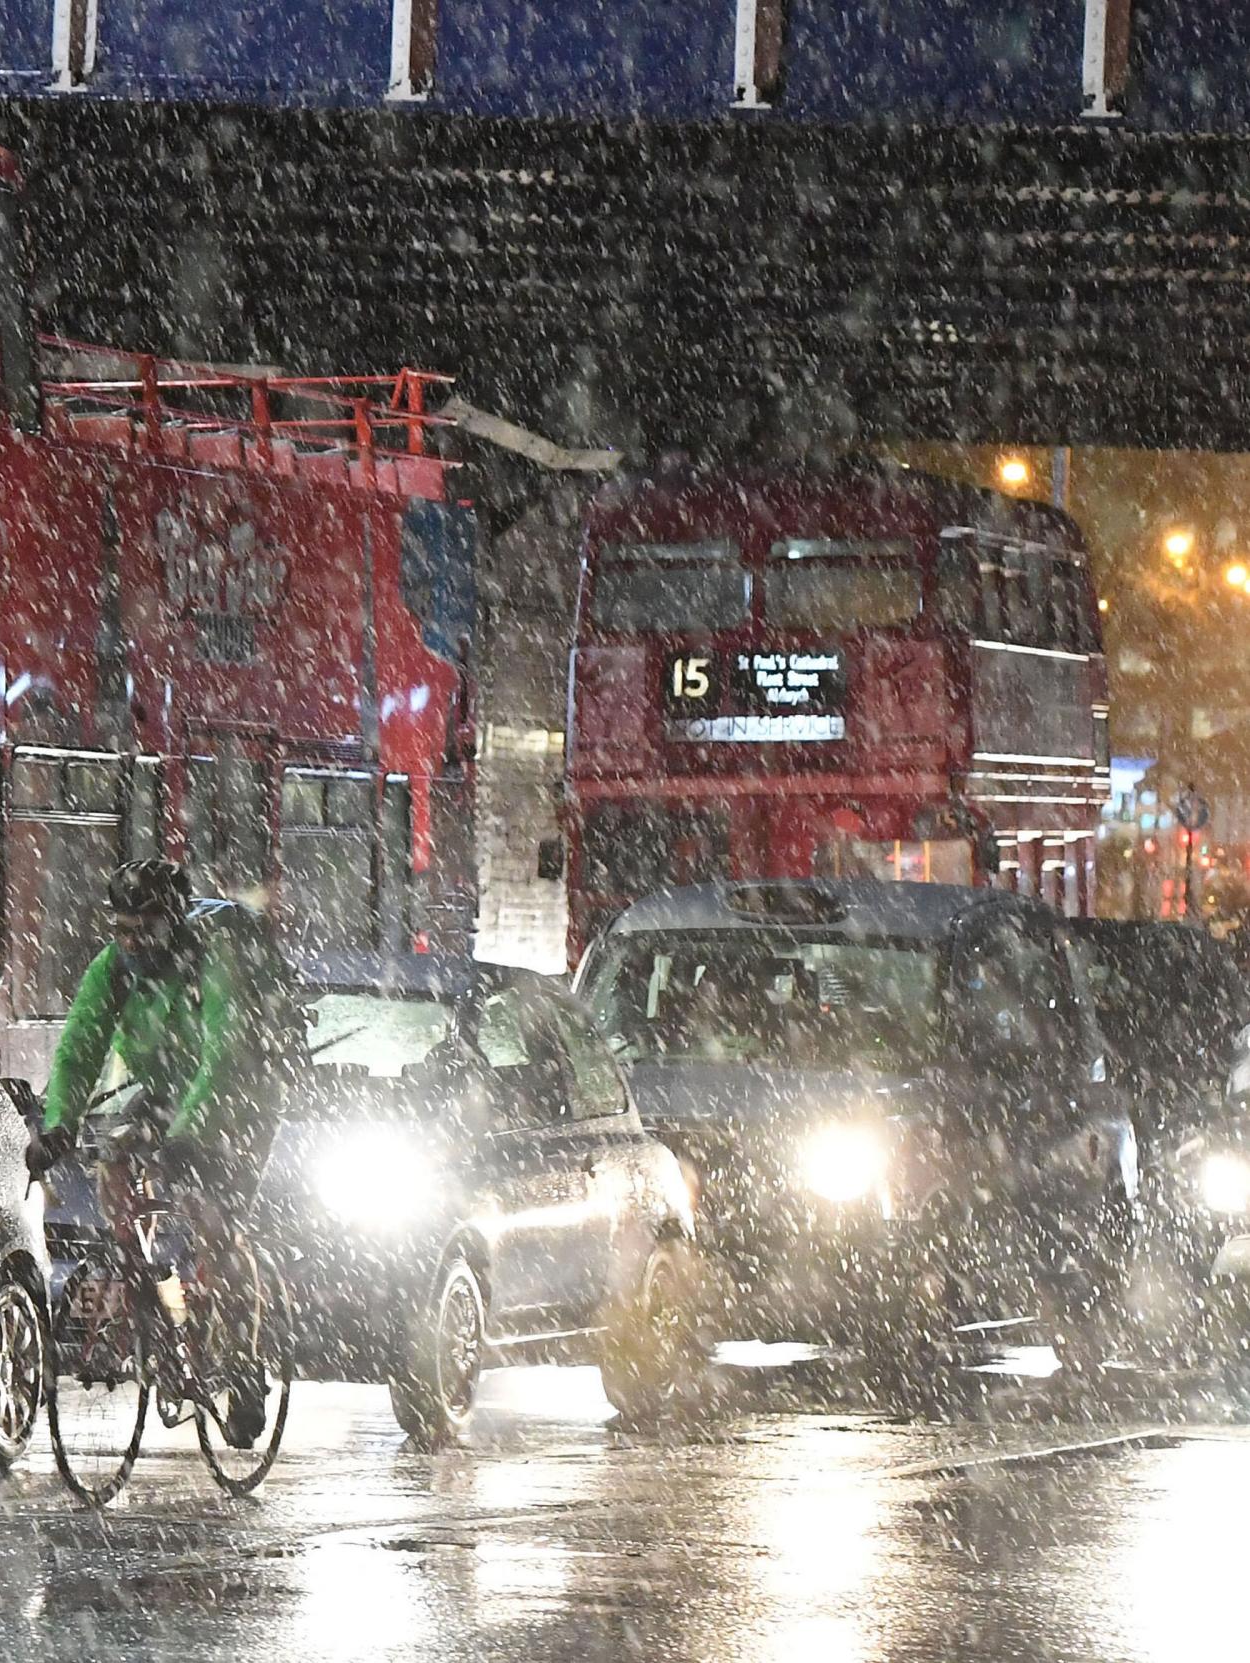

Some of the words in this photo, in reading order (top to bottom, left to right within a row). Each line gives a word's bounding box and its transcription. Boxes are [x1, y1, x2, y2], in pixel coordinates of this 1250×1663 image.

[754, 654, 786, 670] Paul's
[790, 654, 839, 670] Cathedral
[673, 657, 710, 698] 15
[727, 716, 748, 737] IN
[757, 715, 840, 737] SERVICE
